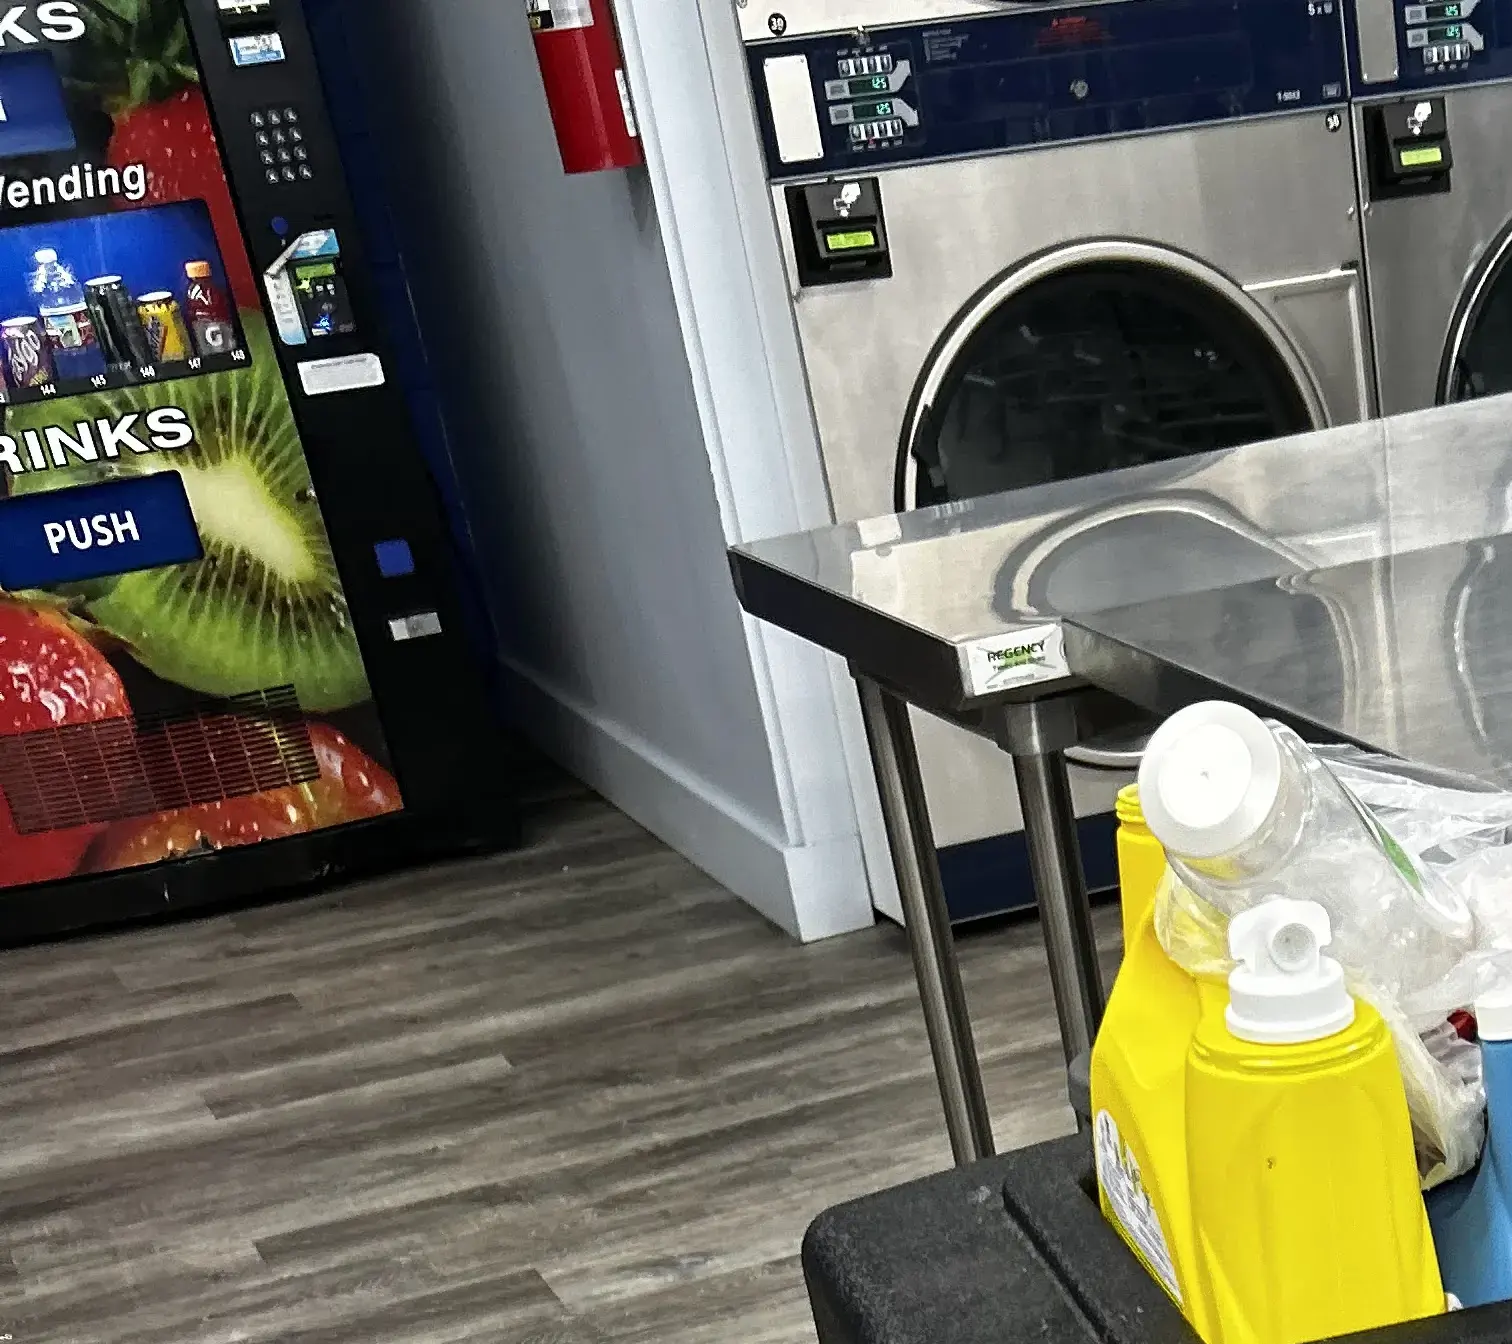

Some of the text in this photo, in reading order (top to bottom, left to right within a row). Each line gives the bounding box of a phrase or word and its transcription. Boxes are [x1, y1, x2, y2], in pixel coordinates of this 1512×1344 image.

[0, 163, 146, 208] ending
[43, 510, 140, 554] PUSH
[987, 640, 1046, 663] REGENCY
